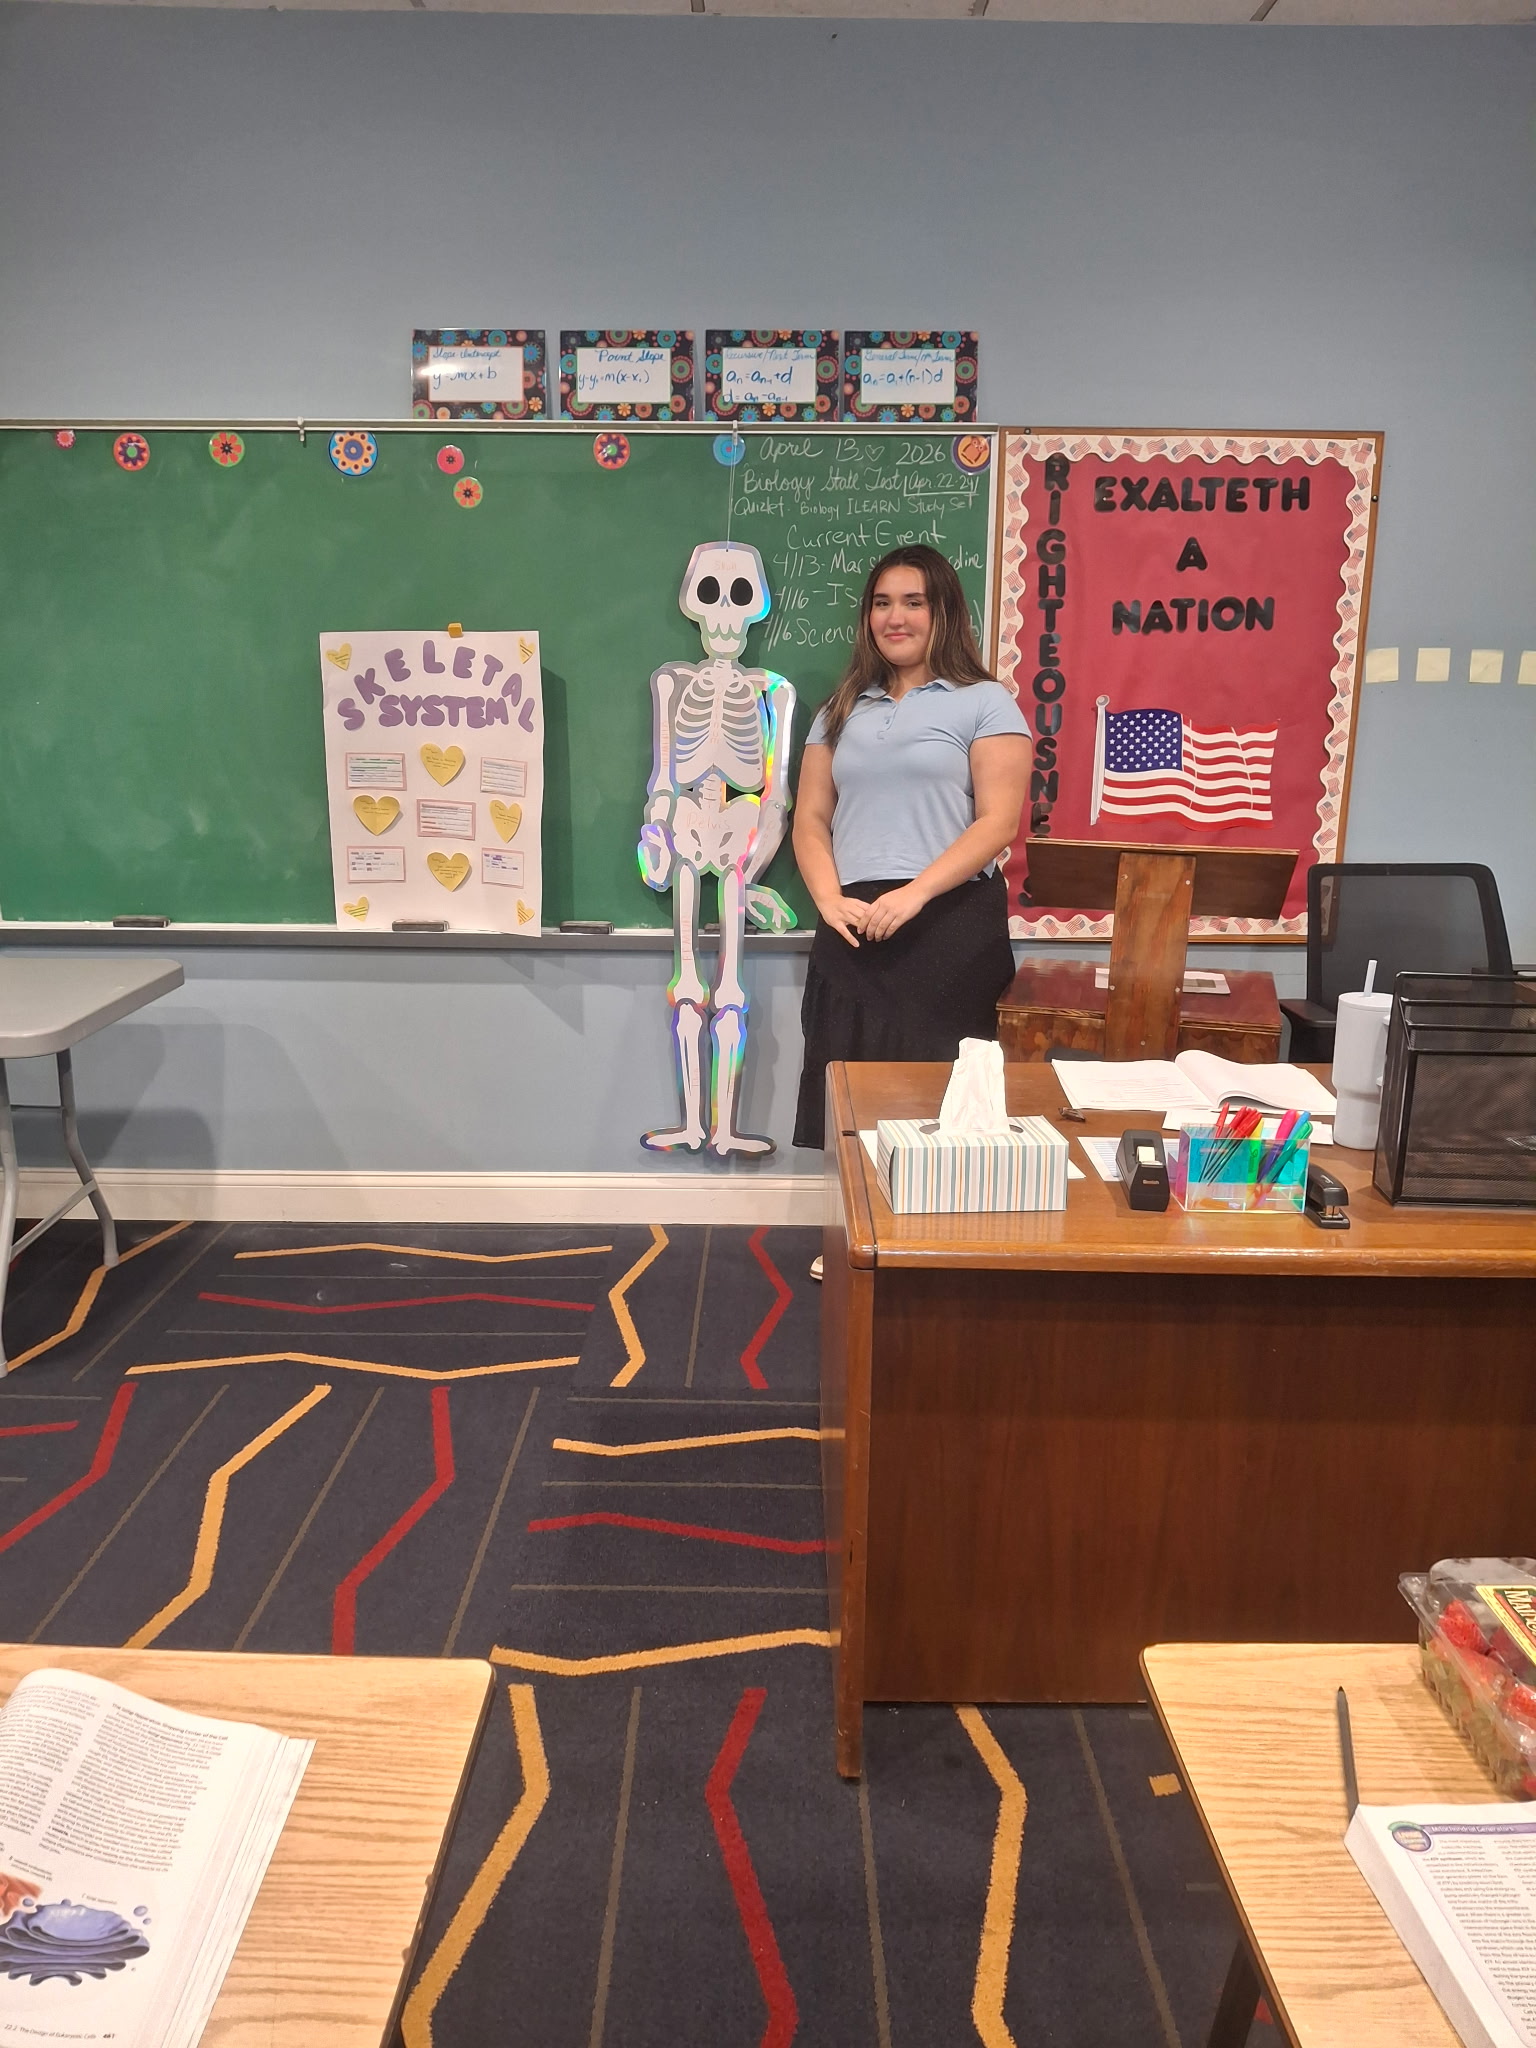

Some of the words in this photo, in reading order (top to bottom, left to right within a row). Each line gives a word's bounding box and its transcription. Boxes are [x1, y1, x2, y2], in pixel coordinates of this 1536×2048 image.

[597, 349, 634, 363] Point
[636, 349, 665, 364] Slope
[760, 436, 823, 463] April
[896, 442, 946, 465] 2026
[744, 468, 815, 503] Biology
[864, 466, 903, 492] Test
[1094, 476, 1310, 512] EXALTETH
[800, 501, 839, 521] Biology
[846, 497, 901, 516] ILEARN
[907, 496, 945, 519] Study
[787, 522, 872, 550] Current
[875, 519, 947, 547] Event
[1176, 536, 1208, 572] A
[1112, 596, 1275, 635] NATION
[378, 694, 509, 728] SYSTEM
[687, 811, 731, 831] Pelvis
